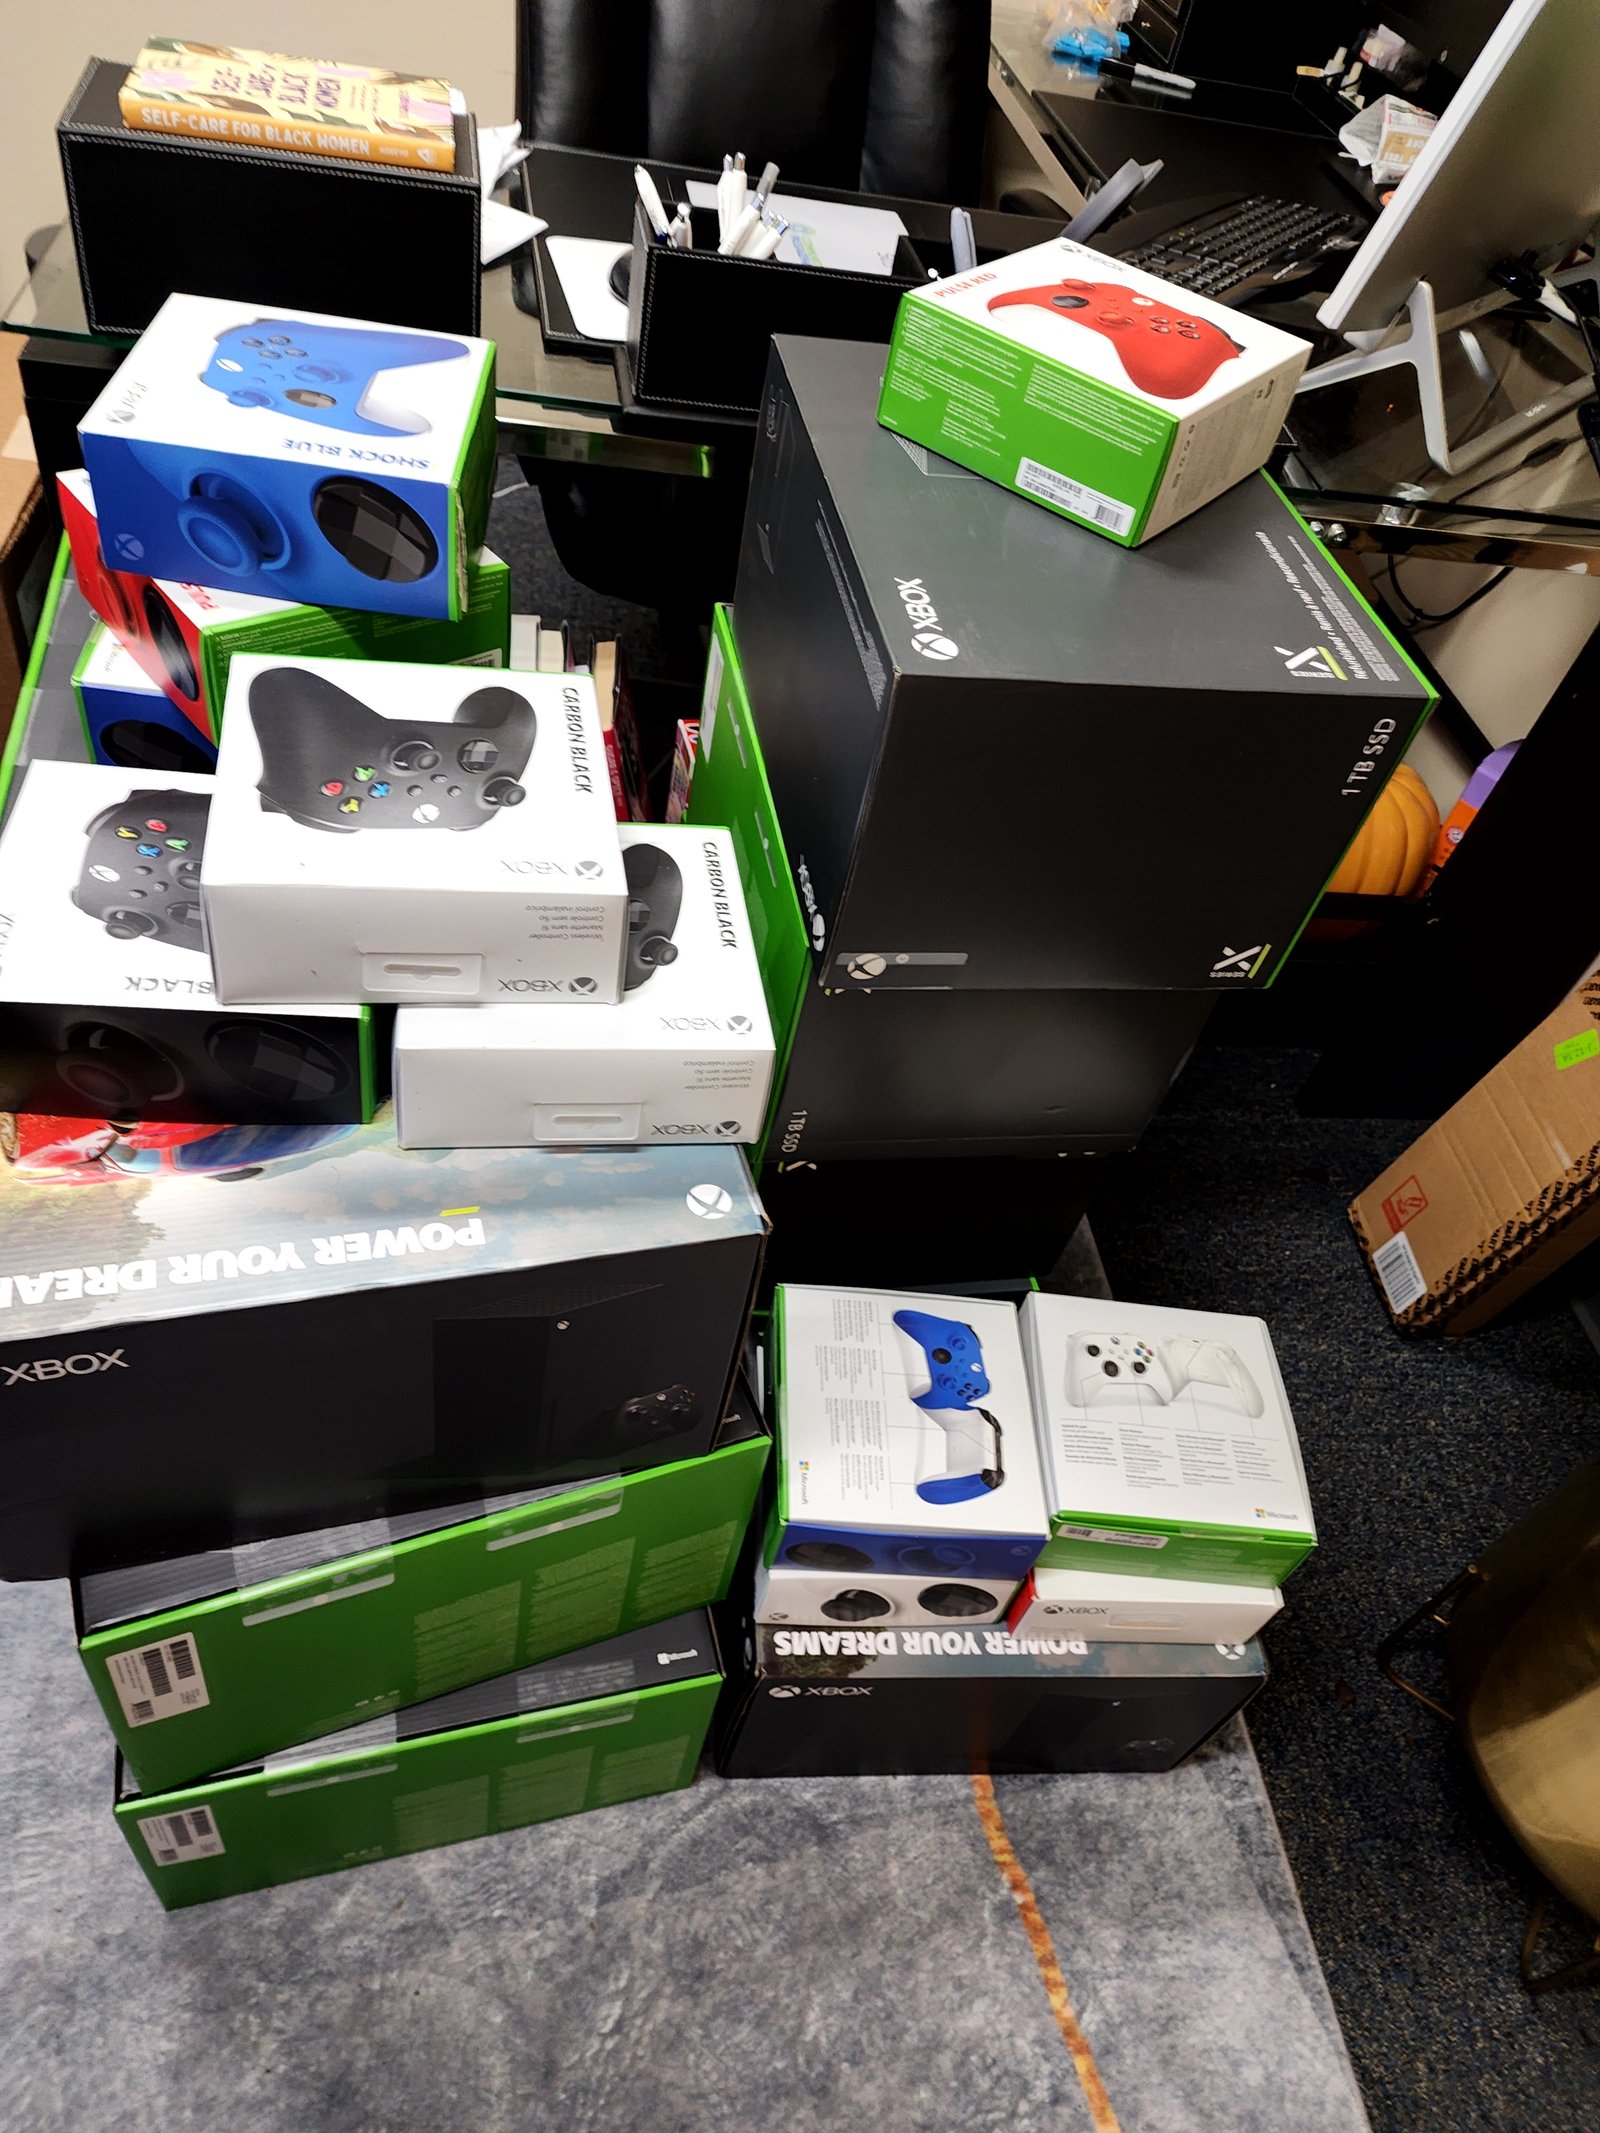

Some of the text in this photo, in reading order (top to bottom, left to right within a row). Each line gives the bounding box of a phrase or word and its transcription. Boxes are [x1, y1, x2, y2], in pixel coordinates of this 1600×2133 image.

[140, 107, 230, 136] SELF-CARE
[232, 120, 262, 141] FOR
[264, 125, 312, 148] BLACK
[316, 133, 371, 155] WOMEN
[282, 436, 431, 470] SHOCK BLUE
[893, 576, 943, 632] XBOX
[561, 686, 593, 795] CARBON BLACK
[1346, 760, 1376, 786] TB
[1362, 717, 1398, 756] SSD
[499, 859, 568, 875] XBOX
[702, 841, 739, 950] CARBON BLACK
[575, 905, 606, 913] Control
[528, 932, 604, 941] Wireless Controller
[124, 976, 216, 995] BLACK
[497, 977, 564, 995] XBOX
[658, 1015, 722, 1031] XBOX
[650, 1122, 712, 1137] XBOX
[787, 1116, 807, 1133] TB
[780, 1131, 802, 1153] SSD
[310, 1216, 488, 1266] POWER
[167, 1235, 307, 1285] YOUR
[0, 1348, 131, 1386] XBOX
[799, 1471, 811, 1507] Microsoft
[1266, 1510, 1299, 1522] Microsoft
[1065, 1604, 1110, 1616] XBOX
[772, 1630, 1089, 1657] POWER YOUR DREAMS
[804, 1685, 875, 1697] XBOX
